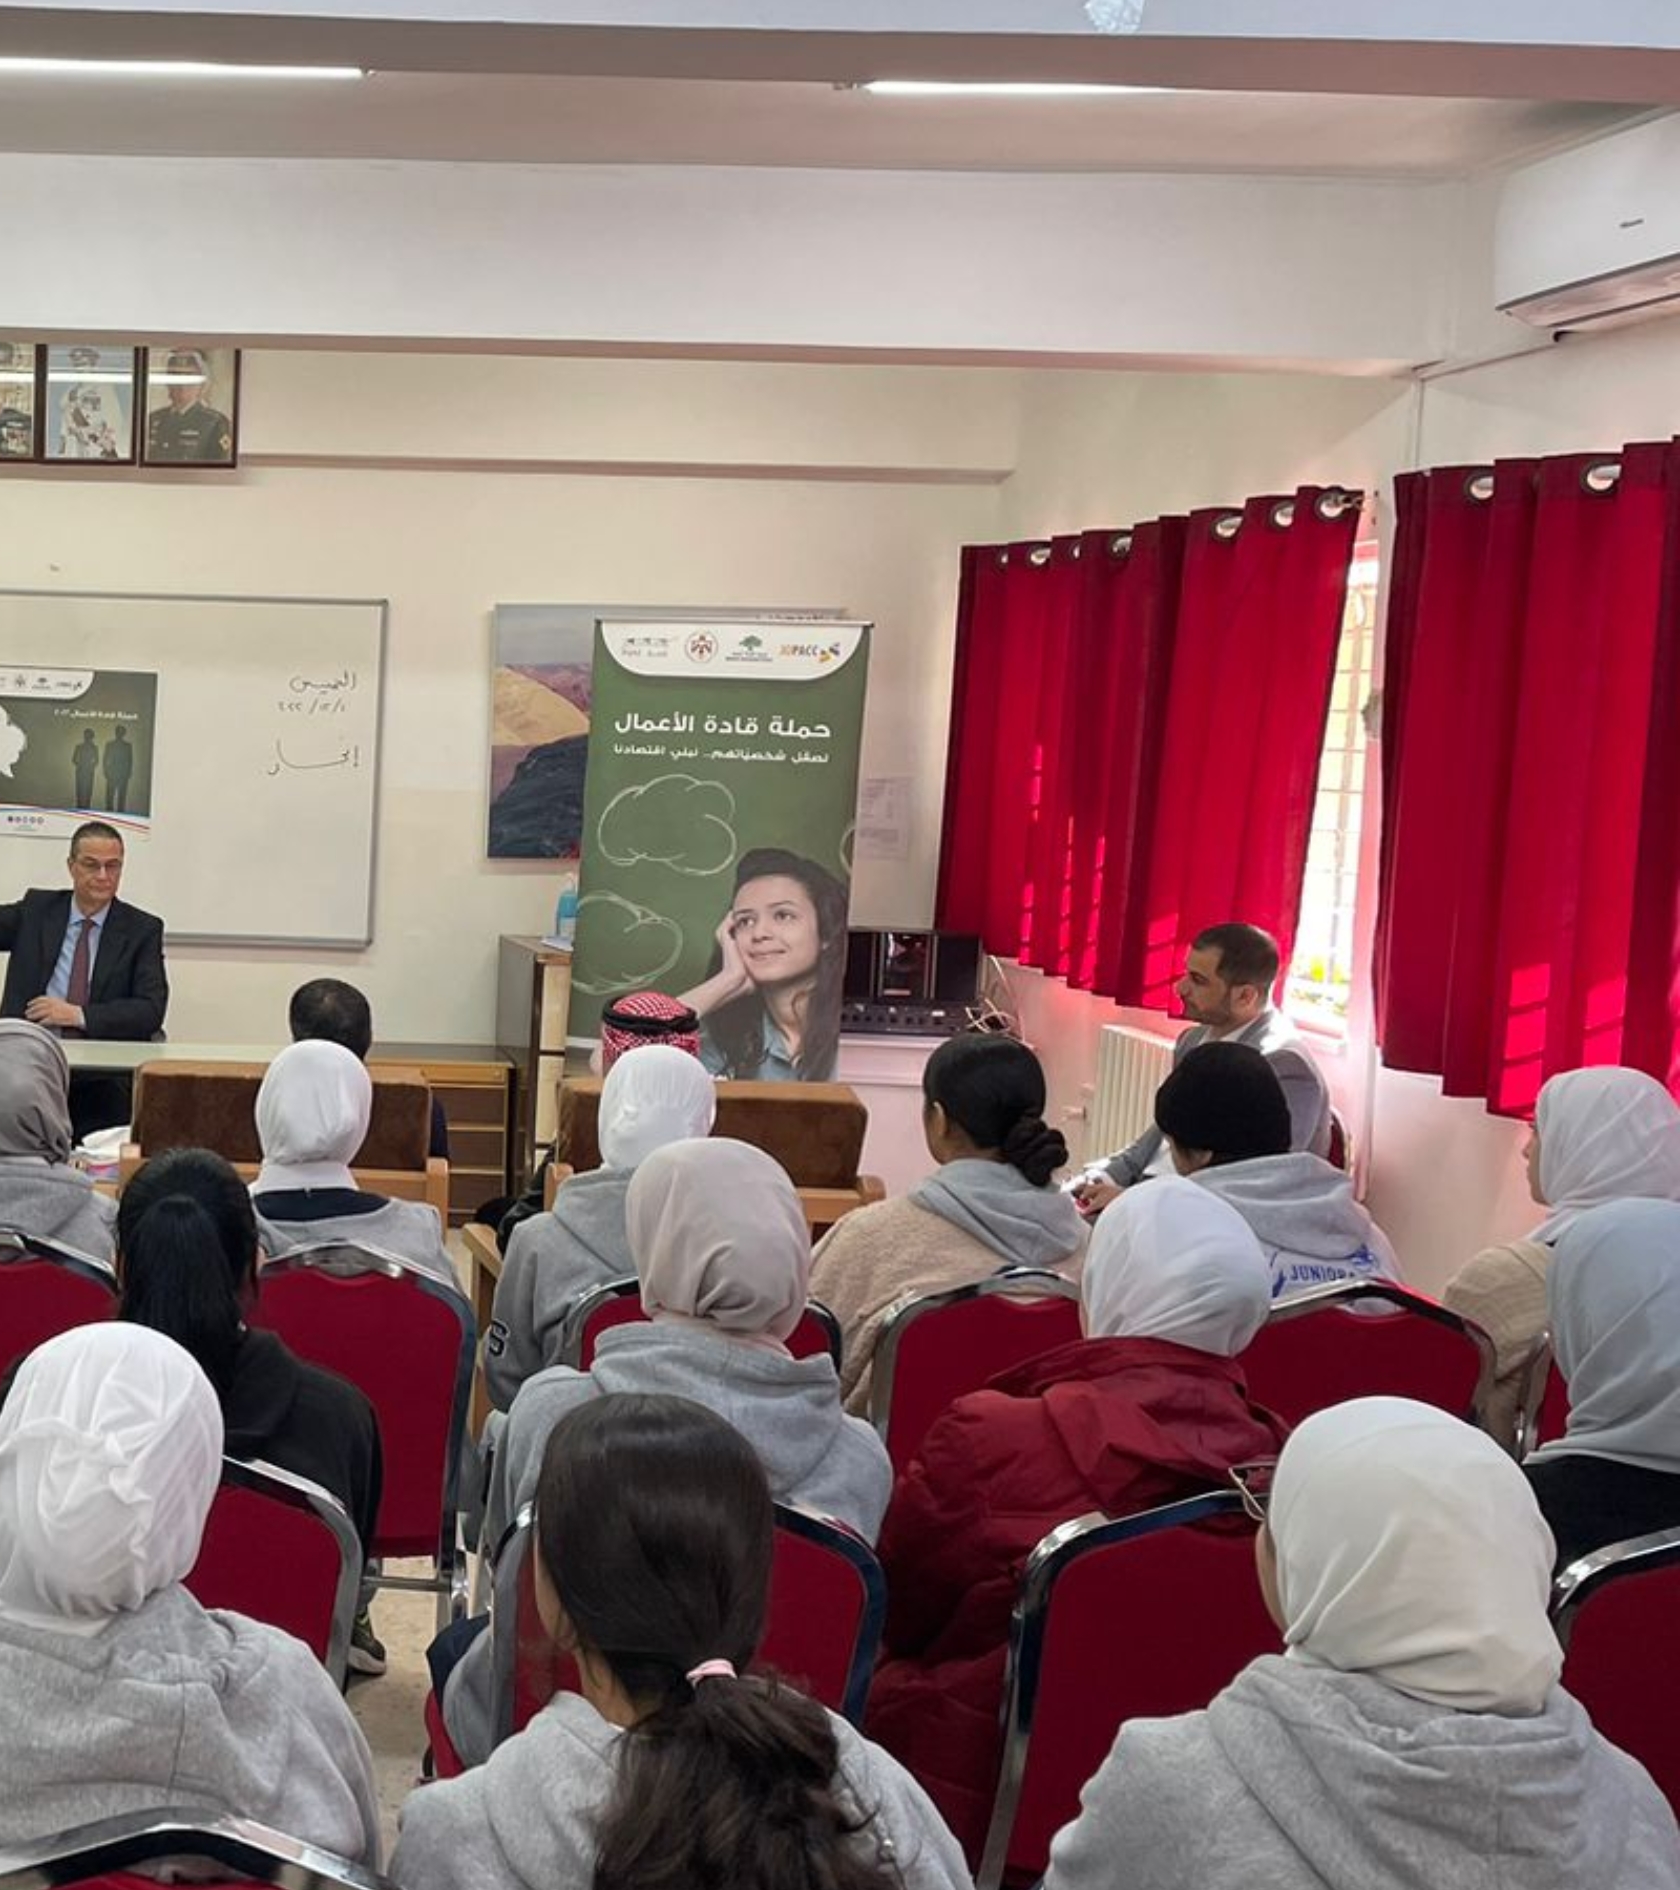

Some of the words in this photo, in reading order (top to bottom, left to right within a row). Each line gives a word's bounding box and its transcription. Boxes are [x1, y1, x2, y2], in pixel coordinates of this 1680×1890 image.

[614, 710, 695, 734] الأعمال
[704, 713, 760, 735] قادة
[769, 714, 832, 738] حملة
